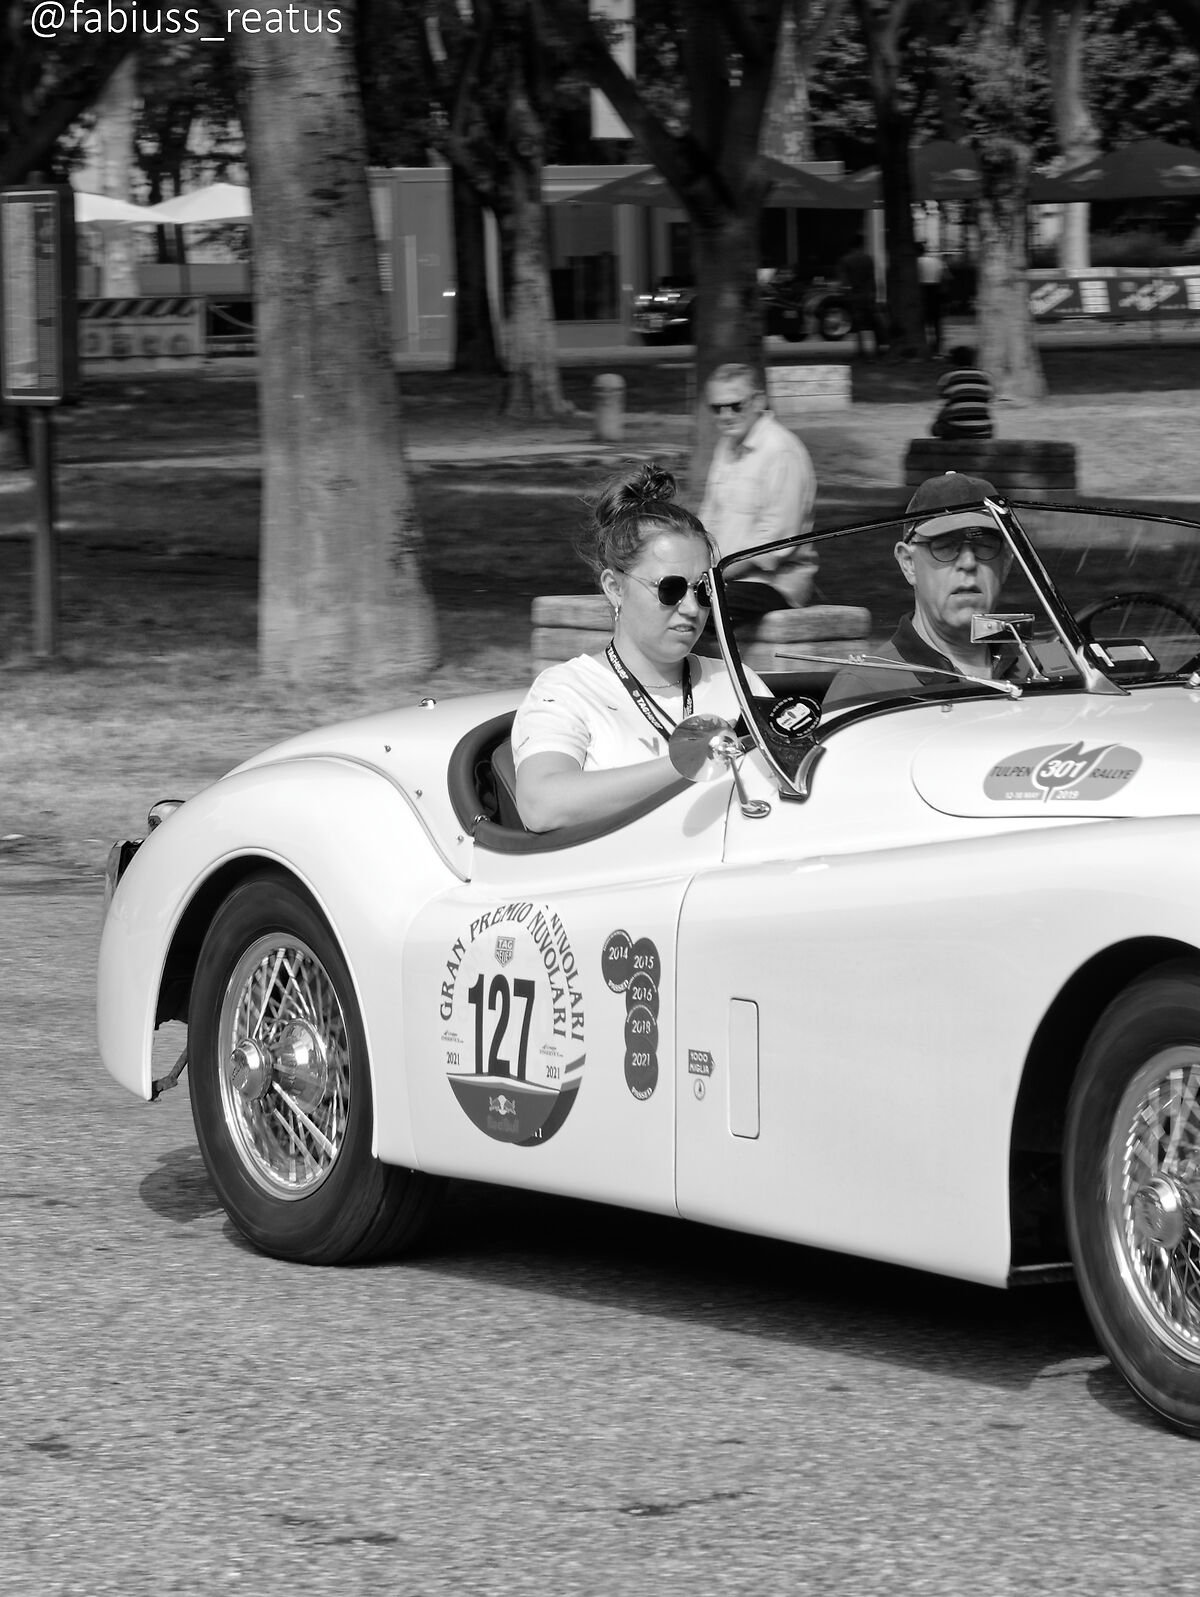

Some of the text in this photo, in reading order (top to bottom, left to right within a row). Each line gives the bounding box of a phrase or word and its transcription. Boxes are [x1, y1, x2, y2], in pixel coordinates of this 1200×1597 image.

[989, 766, 1034, 777] TULPEN
[1040, 760, 1087, 778] 301
[498, 939, 513, 949] TAG
[608, 946, 629, 960] 2014
[633, 955, 655, 969] 2015
[440, 902, 567, 1039] GRAN PREMIO NUVOLARI
[632, 986, 653, 1002] 2016
[468, 973, 536, 1081] 127
[446, 1051, 460, 1066] 2021
[632, 1052, 651, 1067] 2021
[546, 1065, 560, 1079] 2021
